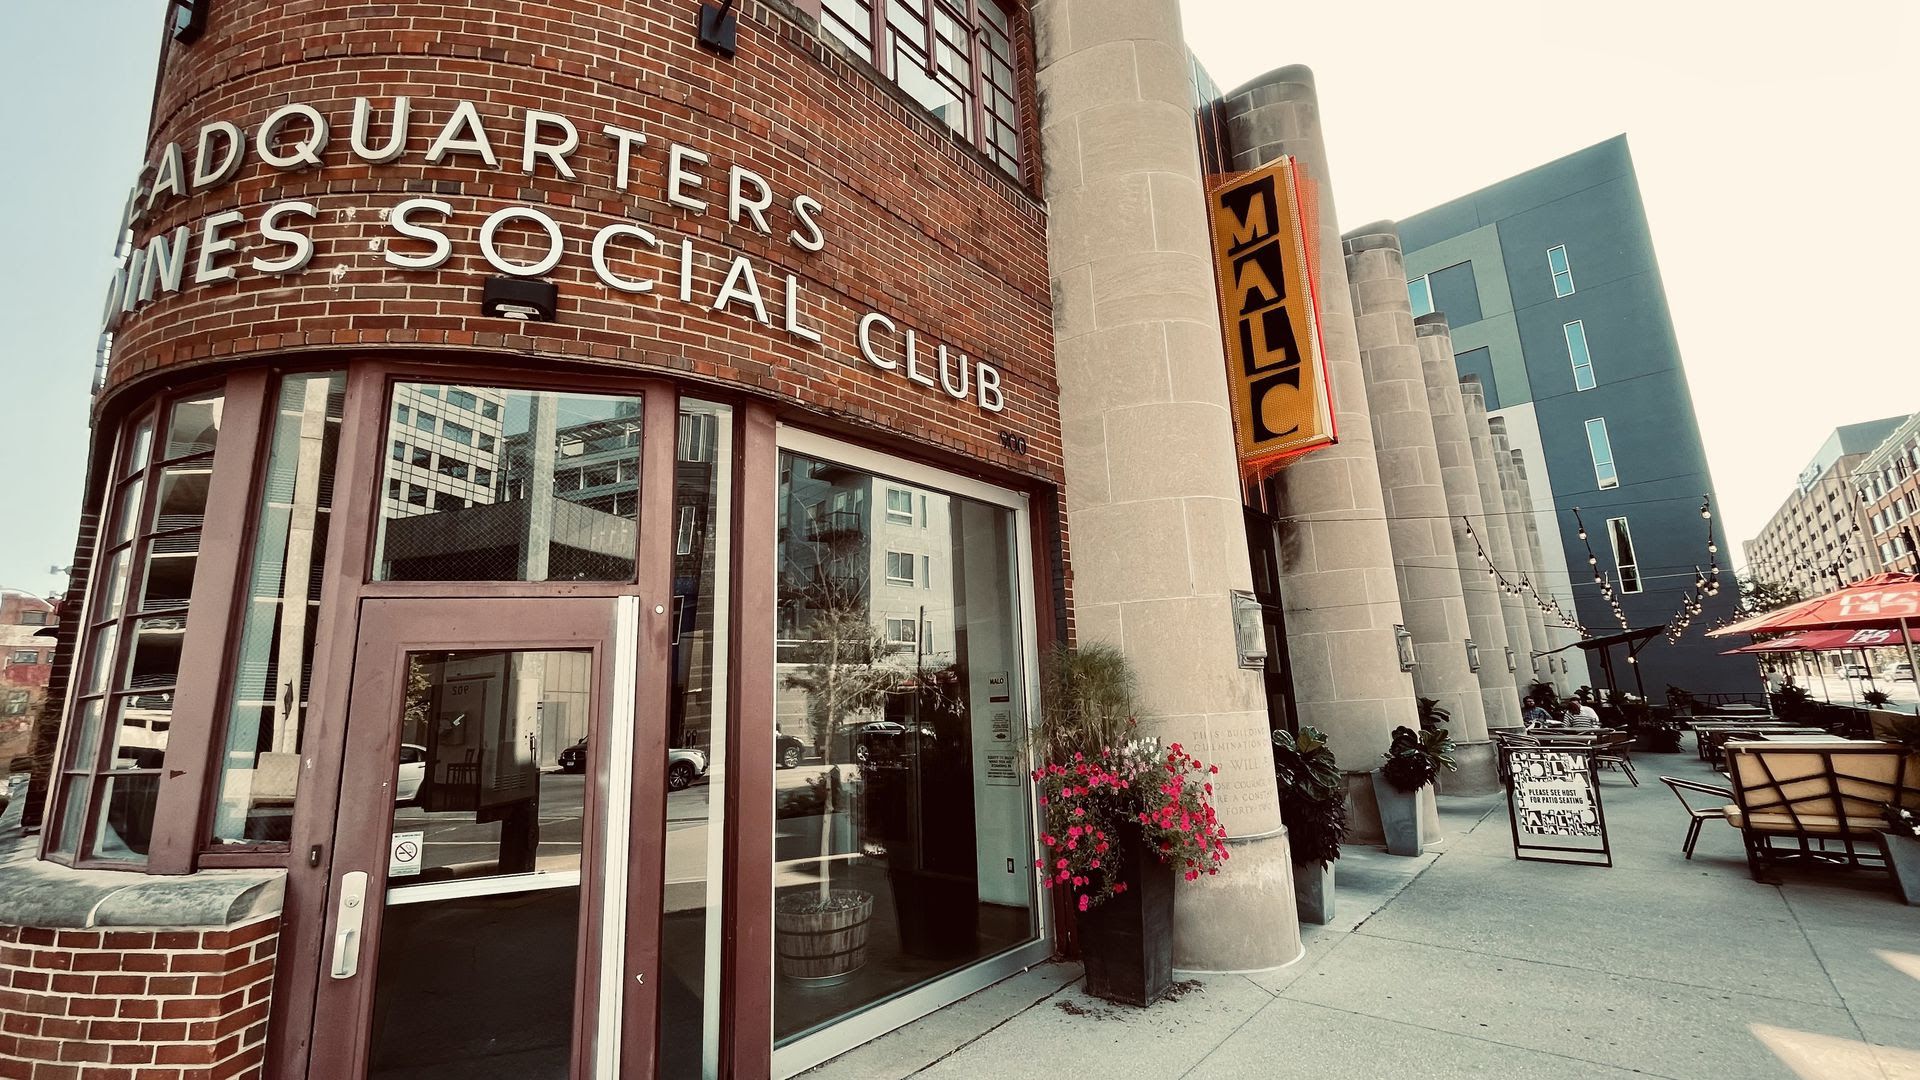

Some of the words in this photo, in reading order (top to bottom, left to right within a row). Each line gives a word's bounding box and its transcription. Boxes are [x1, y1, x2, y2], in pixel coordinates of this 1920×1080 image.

[113, 95, 826, 258] EADQUARTERS
[385, 198, 822, 343] SOCIAL
[858, 311, 1005, 413] CLUB
[998, 430, 1027, 455] 900
[1528, 788, 1549, 796] PLEASE
[1550, 789, 1561, 797] SEE
[1562, 789, 1577, 797] HOST
[1542, 796, 1558, 804] PATIO
[1559, 796, 1584, 805] SEATING
